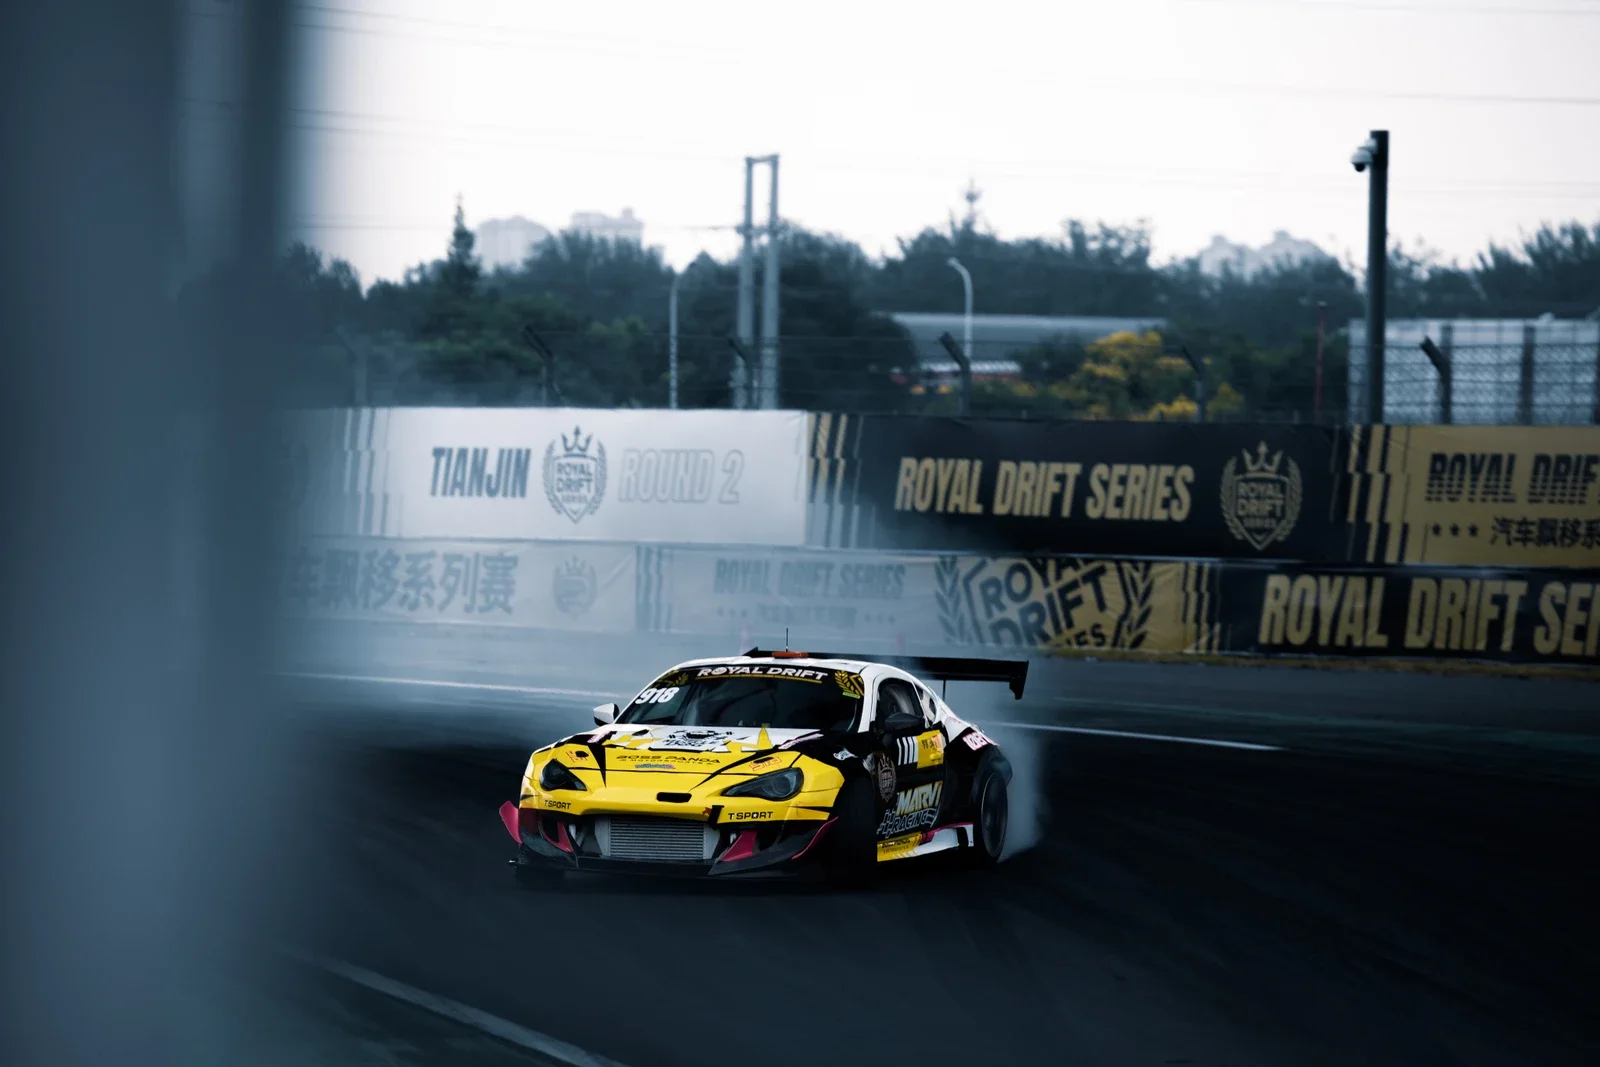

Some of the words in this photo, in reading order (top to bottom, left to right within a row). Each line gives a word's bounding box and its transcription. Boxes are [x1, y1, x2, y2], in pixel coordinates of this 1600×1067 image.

[430, 447, 531, 499] TIANJIN
[618, 449, 716, 503] ROUND
[719, 449, 744, 503] 2
[1425, 452, 1517, 503] ROYAL
[1527, 454, 1600, 505] DRIF
[894, 456, 983, 515] ROYAL
[993, 460, 1083, 518] DRIFT
[1085, 462, 1195, 522] SERIES
[1238, 481, 1284, 497] ROYAL
[713, 558, 773, 596] ROYAL
[988, 564, 1108, 645] DRIFT
[1258, 573, 1388, 648] ROYAL
[1404, 577, 1528, 651] DRIFT
[696, 666, 763, 677] ROYAL
[766, 667, 828, 680] DRIFT
[634, 686, 680, 704] 918
[665, 755, 721, 764] PANDA
[544, 799, 572, 810] TSPORT
[728, 811, 774, 820] TSPORT
[893, 811, 927, 833] RACING
